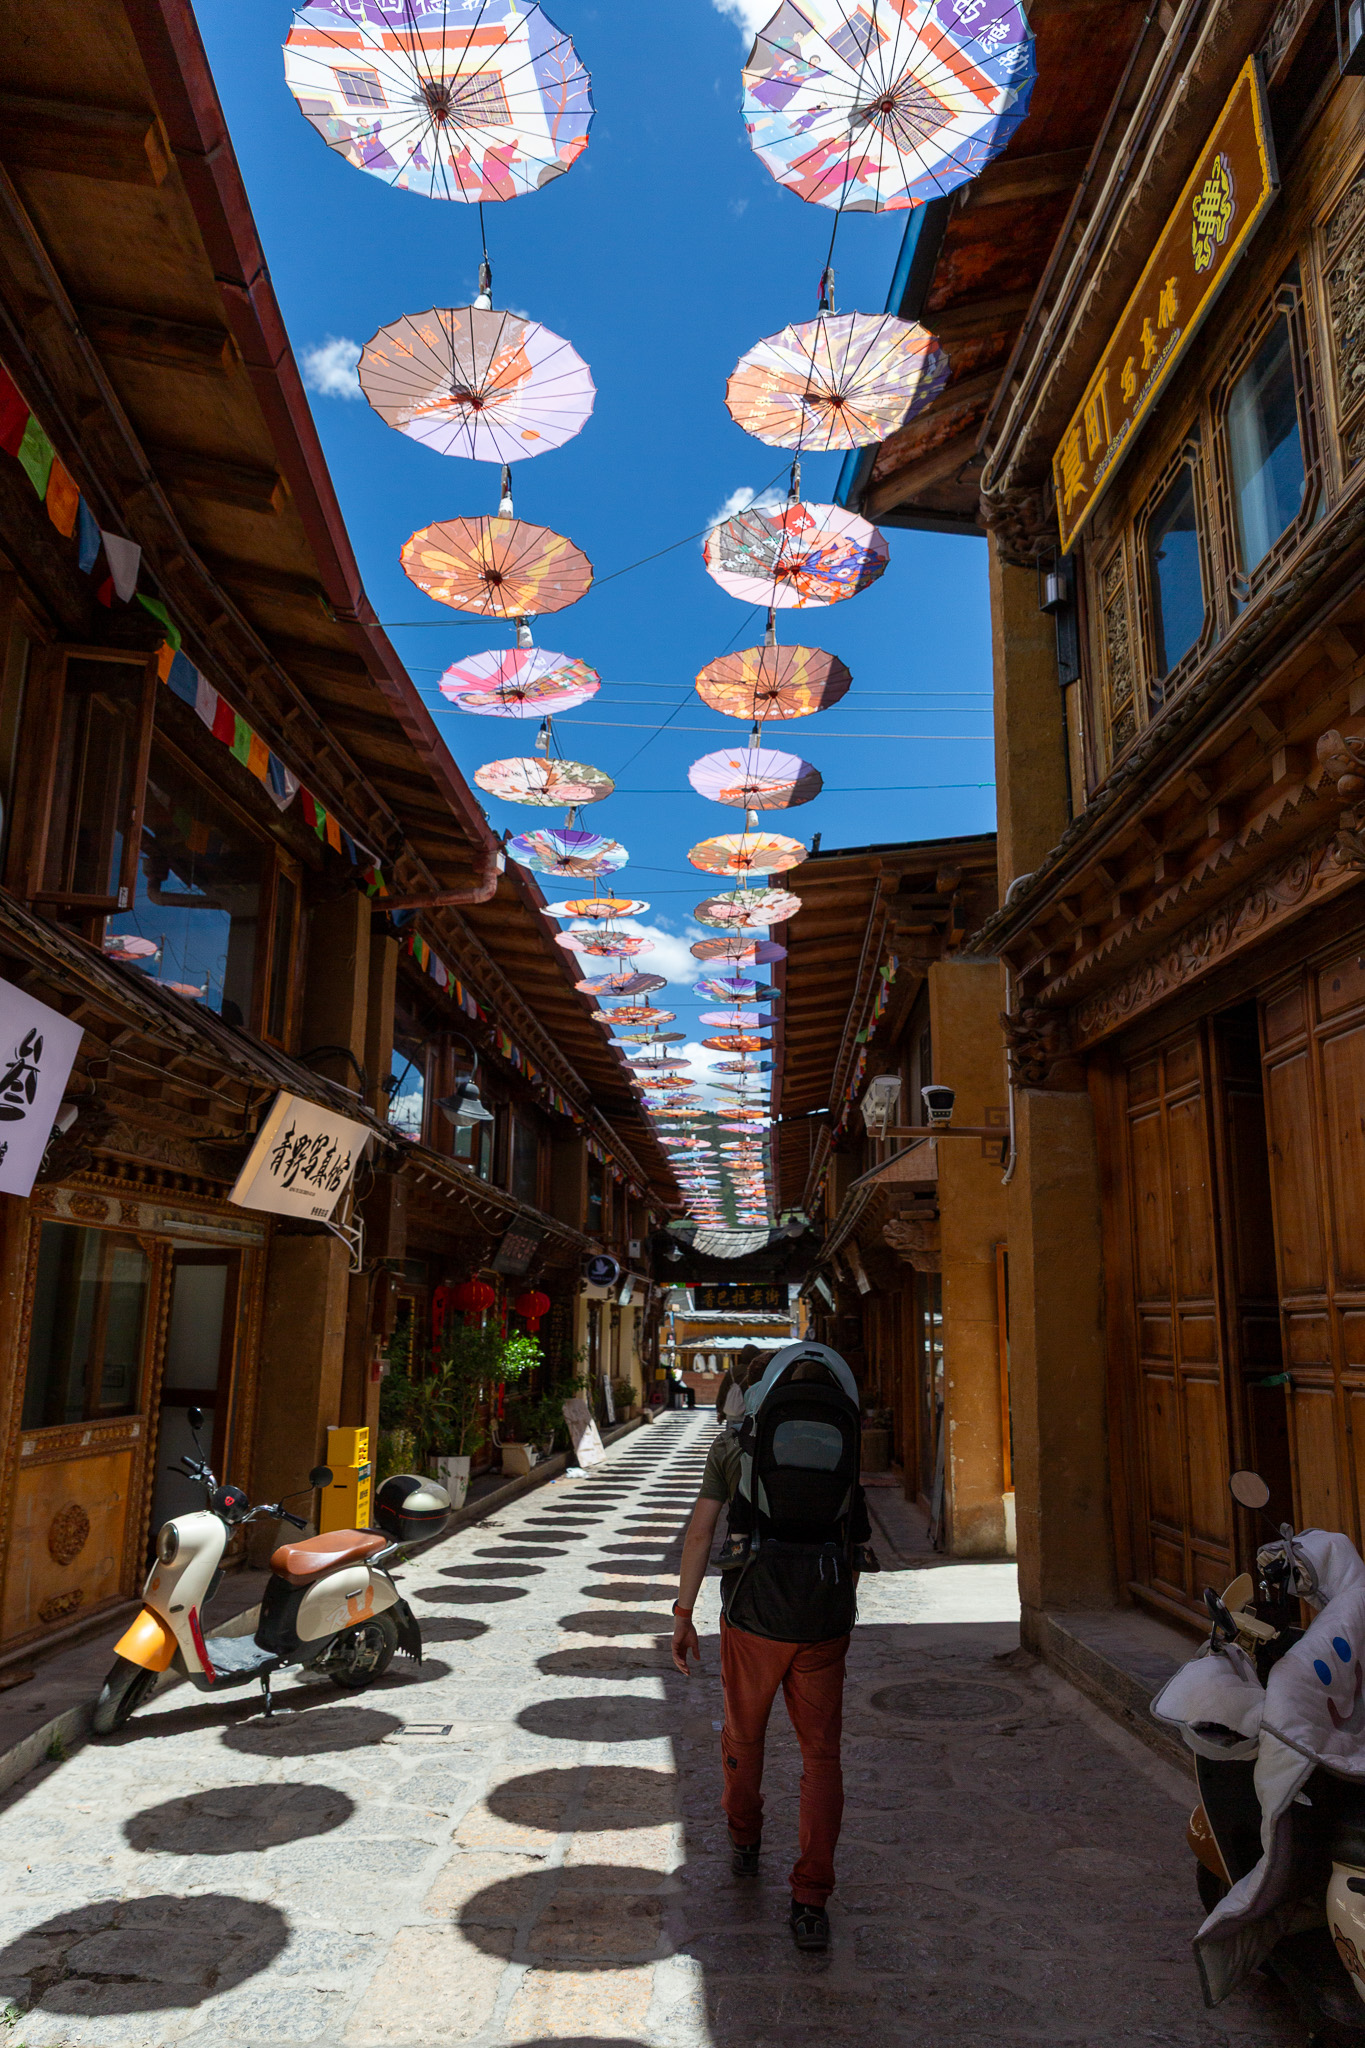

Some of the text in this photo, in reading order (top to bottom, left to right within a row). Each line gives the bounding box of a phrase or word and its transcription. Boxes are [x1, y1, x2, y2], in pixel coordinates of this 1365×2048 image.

[704, 1288, 781, 1308] 香巴拉老街
